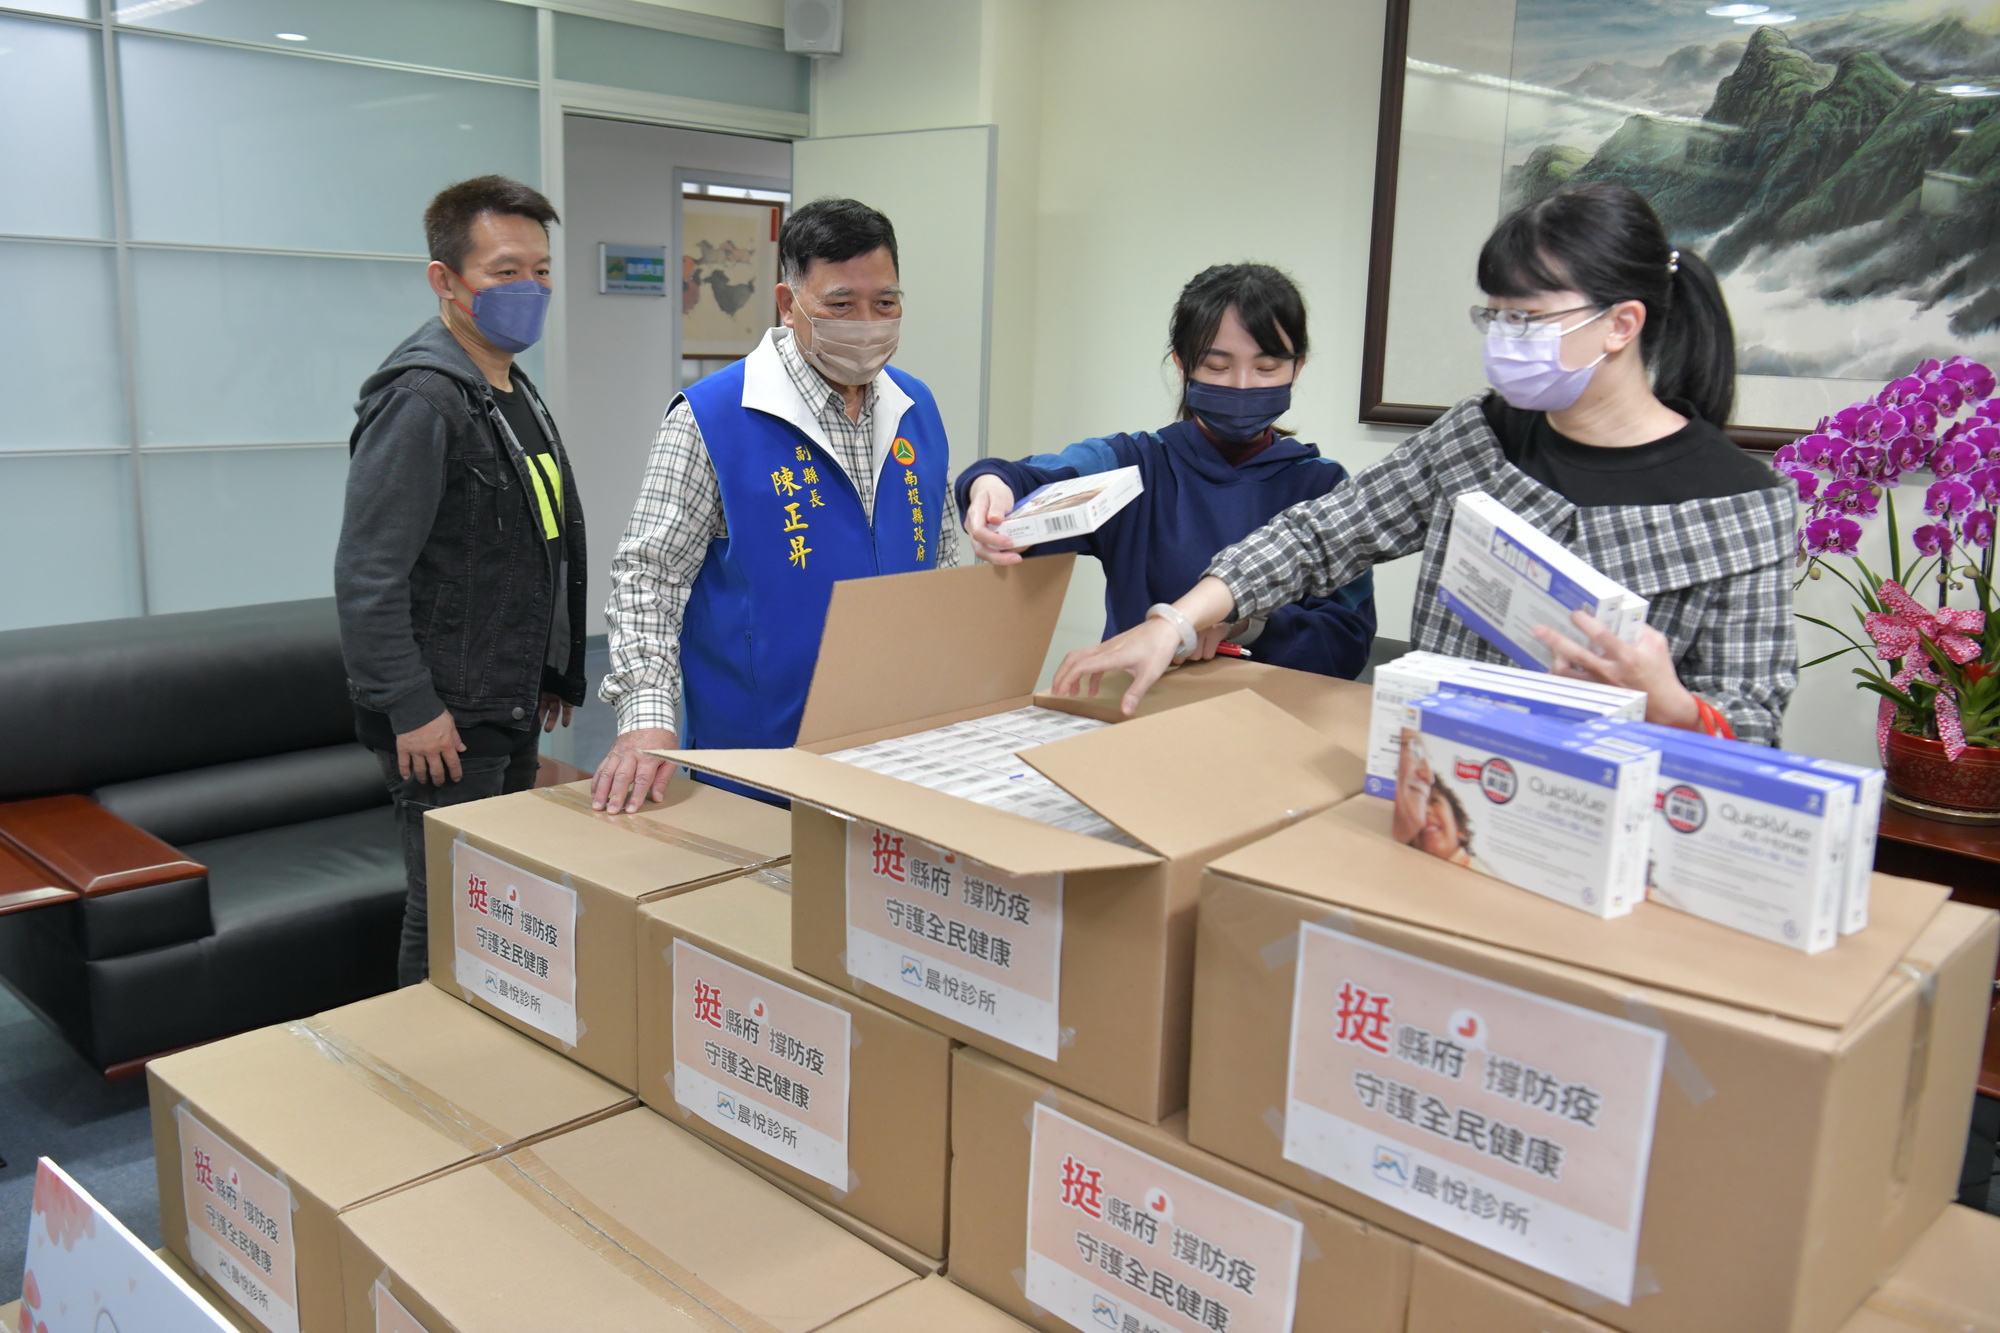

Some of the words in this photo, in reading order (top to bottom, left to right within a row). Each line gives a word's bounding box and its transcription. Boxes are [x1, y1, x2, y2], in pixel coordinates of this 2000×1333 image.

[795, 444, 826, 508] 副縣長
[903, 468, 927, 562] 南投縣政府
[1527, 775, 1607, 813] QuickVue
[1719, 802, 1812, 842] QuickVue
[476, 926, 549, 979] 守護全民健康
[886, 898, 1012, 968] 守護全民健康
[498, 980, 541, 1014] 晨悅診所
[925, 968, 996, 1015] 晨悅診所
[704, 1040, 810, 1111] 守護全民健康
[737, 1104, 798, 1149] 晨悅診所
[1353, 1071, 1563, 1180] 守護全民健康
[1411, 1165, 1530, 1236] 晨悅診所
[1075, 1230, 1231, 1333] 守護全民健康
